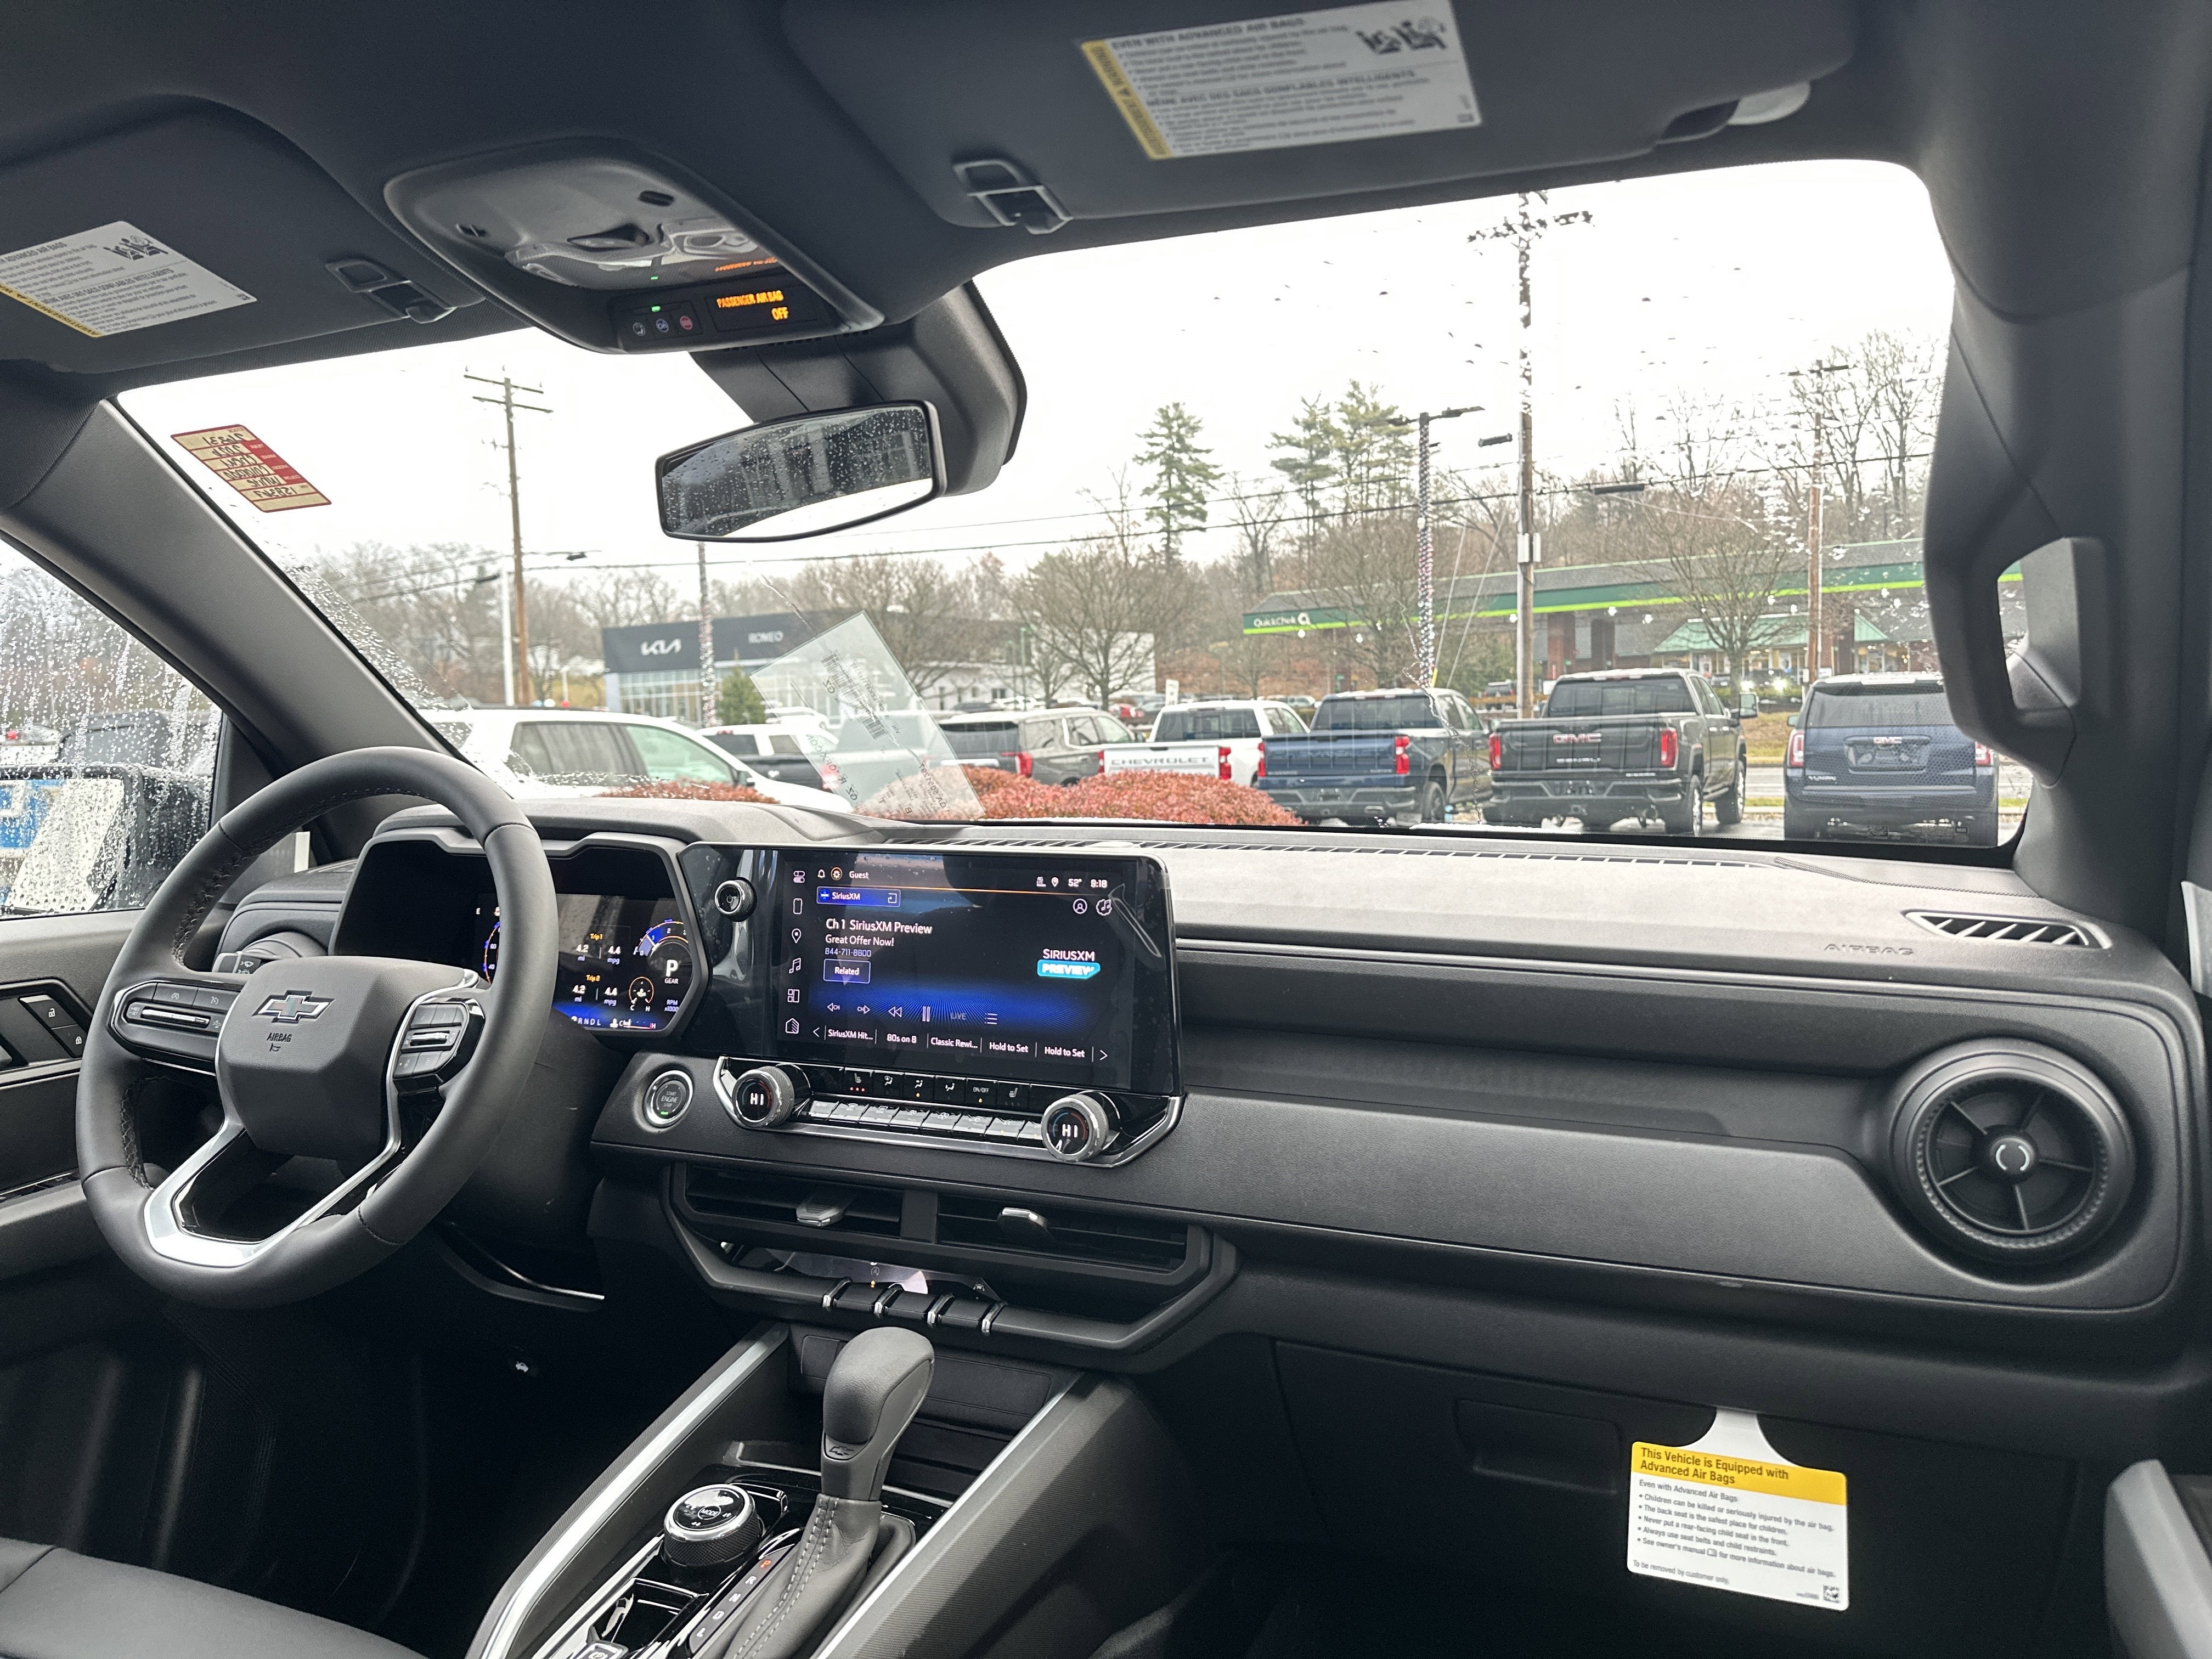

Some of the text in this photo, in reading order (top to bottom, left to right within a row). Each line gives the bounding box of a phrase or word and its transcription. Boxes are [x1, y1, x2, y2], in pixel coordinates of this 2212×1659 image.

[131, 268, 176, 281] INTELLIGENTS
[716, 290, 783, 308] PASSENGER AIR BAG
[771, 307, 788, 320] OFF
[1553, 733, 1602, 744] GMC
[1111, 757, 1207, 765] CHEVROLET
[1068, 878, 1107, 888] 52° 9:18
[826, 918, 932, 934] Ch 1 SiriusXM Preview
[825, 934, 894, 946] Great Offer Now!
[576, 944, 620, 955] 4.2 4.4
[825, 947, 871, 957] 844-711-8800
[1043, 949, 1094, 961] SIRIUSXM
[1824, 944, 1914, 955] AIRBAG
[665, 959, 678, 977] P
[834, 967, 860, 975] Related
[1042, 964, 1094, 975] PREVIEW
[605, 988, 617, 996] 4.4
[267, 1032, 292, 1042] AIRBAG
[828, 1029, 873, 1040] SiriusXM Hit...
[887, 1034, 900, 1042] 80s
[931, 1037, 978, 1048] Classic Rewi...
[989, 1042, 1006, 1051] Hold
[1016, 1045, 1029, 1053] Set
[1045, 1046, 1062, 1056] Hold
[1072, 1049, 1085, 1057] Set
[750, 1093, 764, 1105] HI
[1062, 1124, 1077, 1138] HI
[1641, 1447, 1788, 1480] This Vehicle is Equipped with
[1640, 1459, 1734, 1486] Advanced Air Bags
[1639, 1479, 1655, 1488] Even
[1657, 1482, 1671, 1491] with
[1673, 1485, 1706, 1497] Advanced
[1720, 1493, 1737, 1503] Bags
[1644, 1493, 1671, 1504] Children
[1697, 1502, 1715, 1511] killed
[1725, 1507, 1756, 1519] seriously
[1758, 1513, 1781, 1523] injured
[1784, 1517, 1791, 1525] by
[1819, 1522, 1833, 1532] bag.
[1657, 1506, 1672, 1515] back
[1708, 1515, 1726, 1524] safest
[1729, 1519, 1746, 1529] place
[1759, 1524, 1787, 1534] children.
[1644, 1515, 1661, 1524] Never
[1663, 1519, 1673, 1527] put
[1681, 1522, 1716, 1534] rear-facing
[1718, 1528, 1733, 1537] child
[1771, 1537, 1787, 1546] front.
[1643, 1526, 1665, 1537] Always
[1680, 1533, 1694, 1541] seat
[1695, 1536, 1711, 1544] belts
[1726, 1541, 1741, 1549] child
[1743, 1544, 1776, 1555] restraints.
[760, 1560, 771, 1568] P
[1656, 1540, 1680, 1550] owner's
[1683, 1544, 1705, 1554] manual
[1748, 1556, 1784, 1568] information
[1786, 1563, 1804, 1572] about
[1818, 1568, 1835, 1579] bags.
[1650, 1563, 1675, 1573] removed
[1677, 1568, 1684, 1576] by
[1686, 1570, 1713, 1581] customer
[1716, 1575, 1729, 1584] only.
[745, 1576, 757, 1585] R
[729, 1594, 741, 1602] N
[712, 1611, 724, 1620] D
[696, 1628, 706, 1637] L
